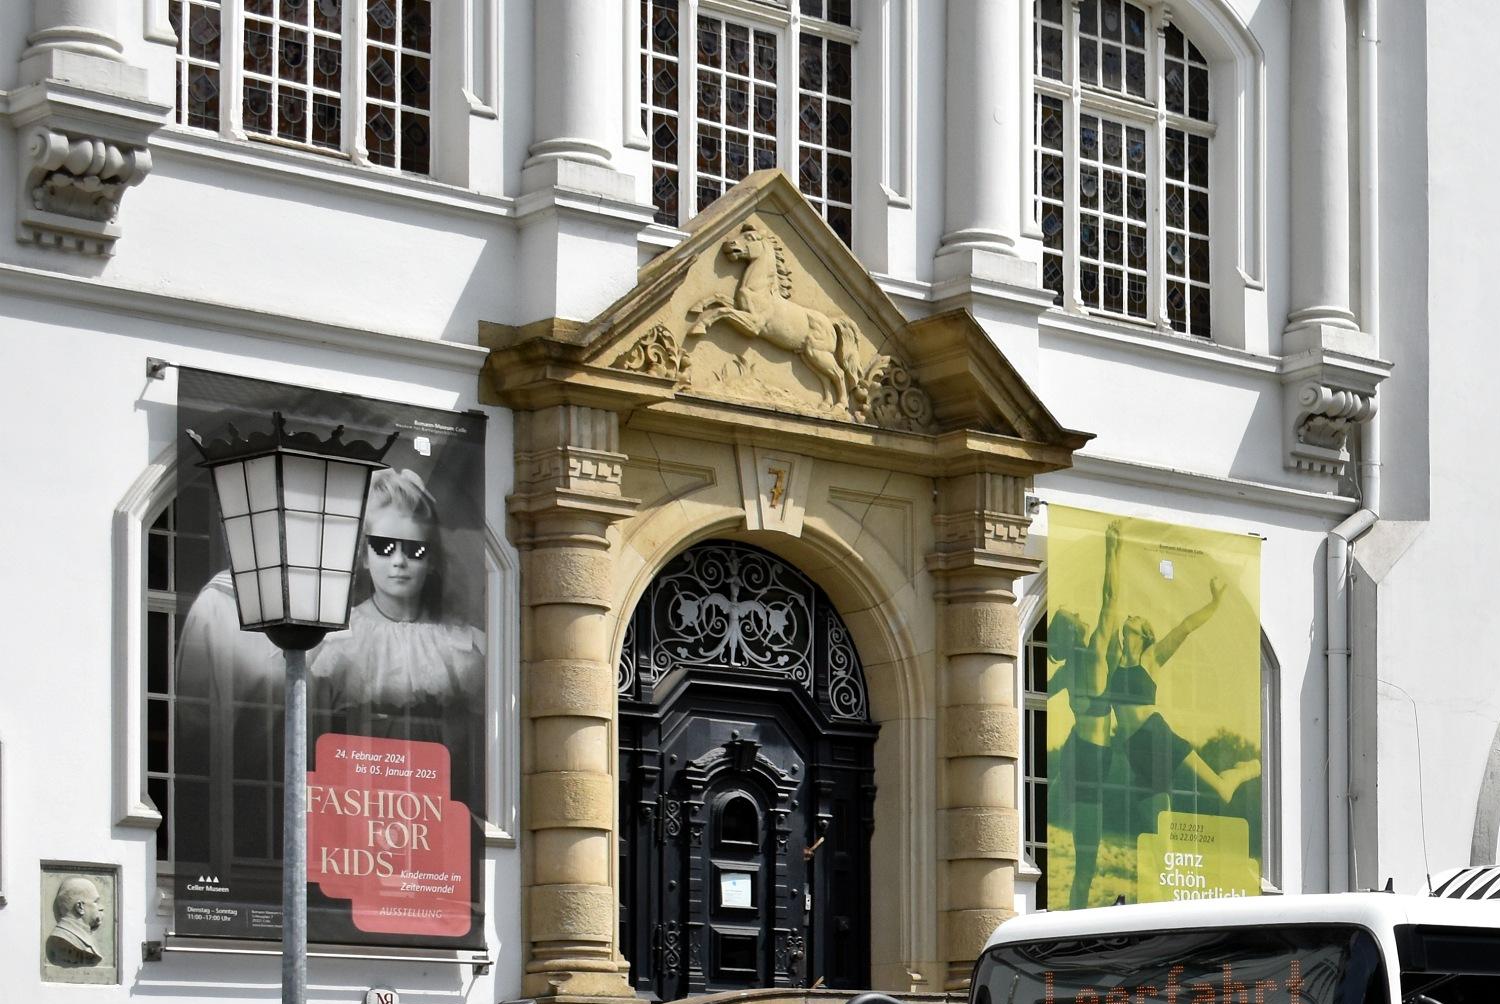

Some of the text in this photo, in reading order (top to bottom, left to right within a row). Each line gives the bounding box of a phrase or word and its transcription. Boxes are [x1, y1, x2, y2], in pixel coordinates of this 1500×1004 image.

[335, 749, 406, 764] 24. Februar 2024
[355, 764, 437, 779] bis 05. Januar 2025
[306, 785, 442, 822] FASHION
[367, 820, 431, 851] FOR
[320, 847, 394, 878] KIDS
[1164, 852, 1203, 871] ganz
[400, 870, 461, 882] Kindermode im
[1160, 869, 1206, 888] schön
[205, 885, 229, 893] Museen
[400, 882, 455, 894] Zeitenwandel
[379, 906, 443, 919] AUSSTELLUNG
